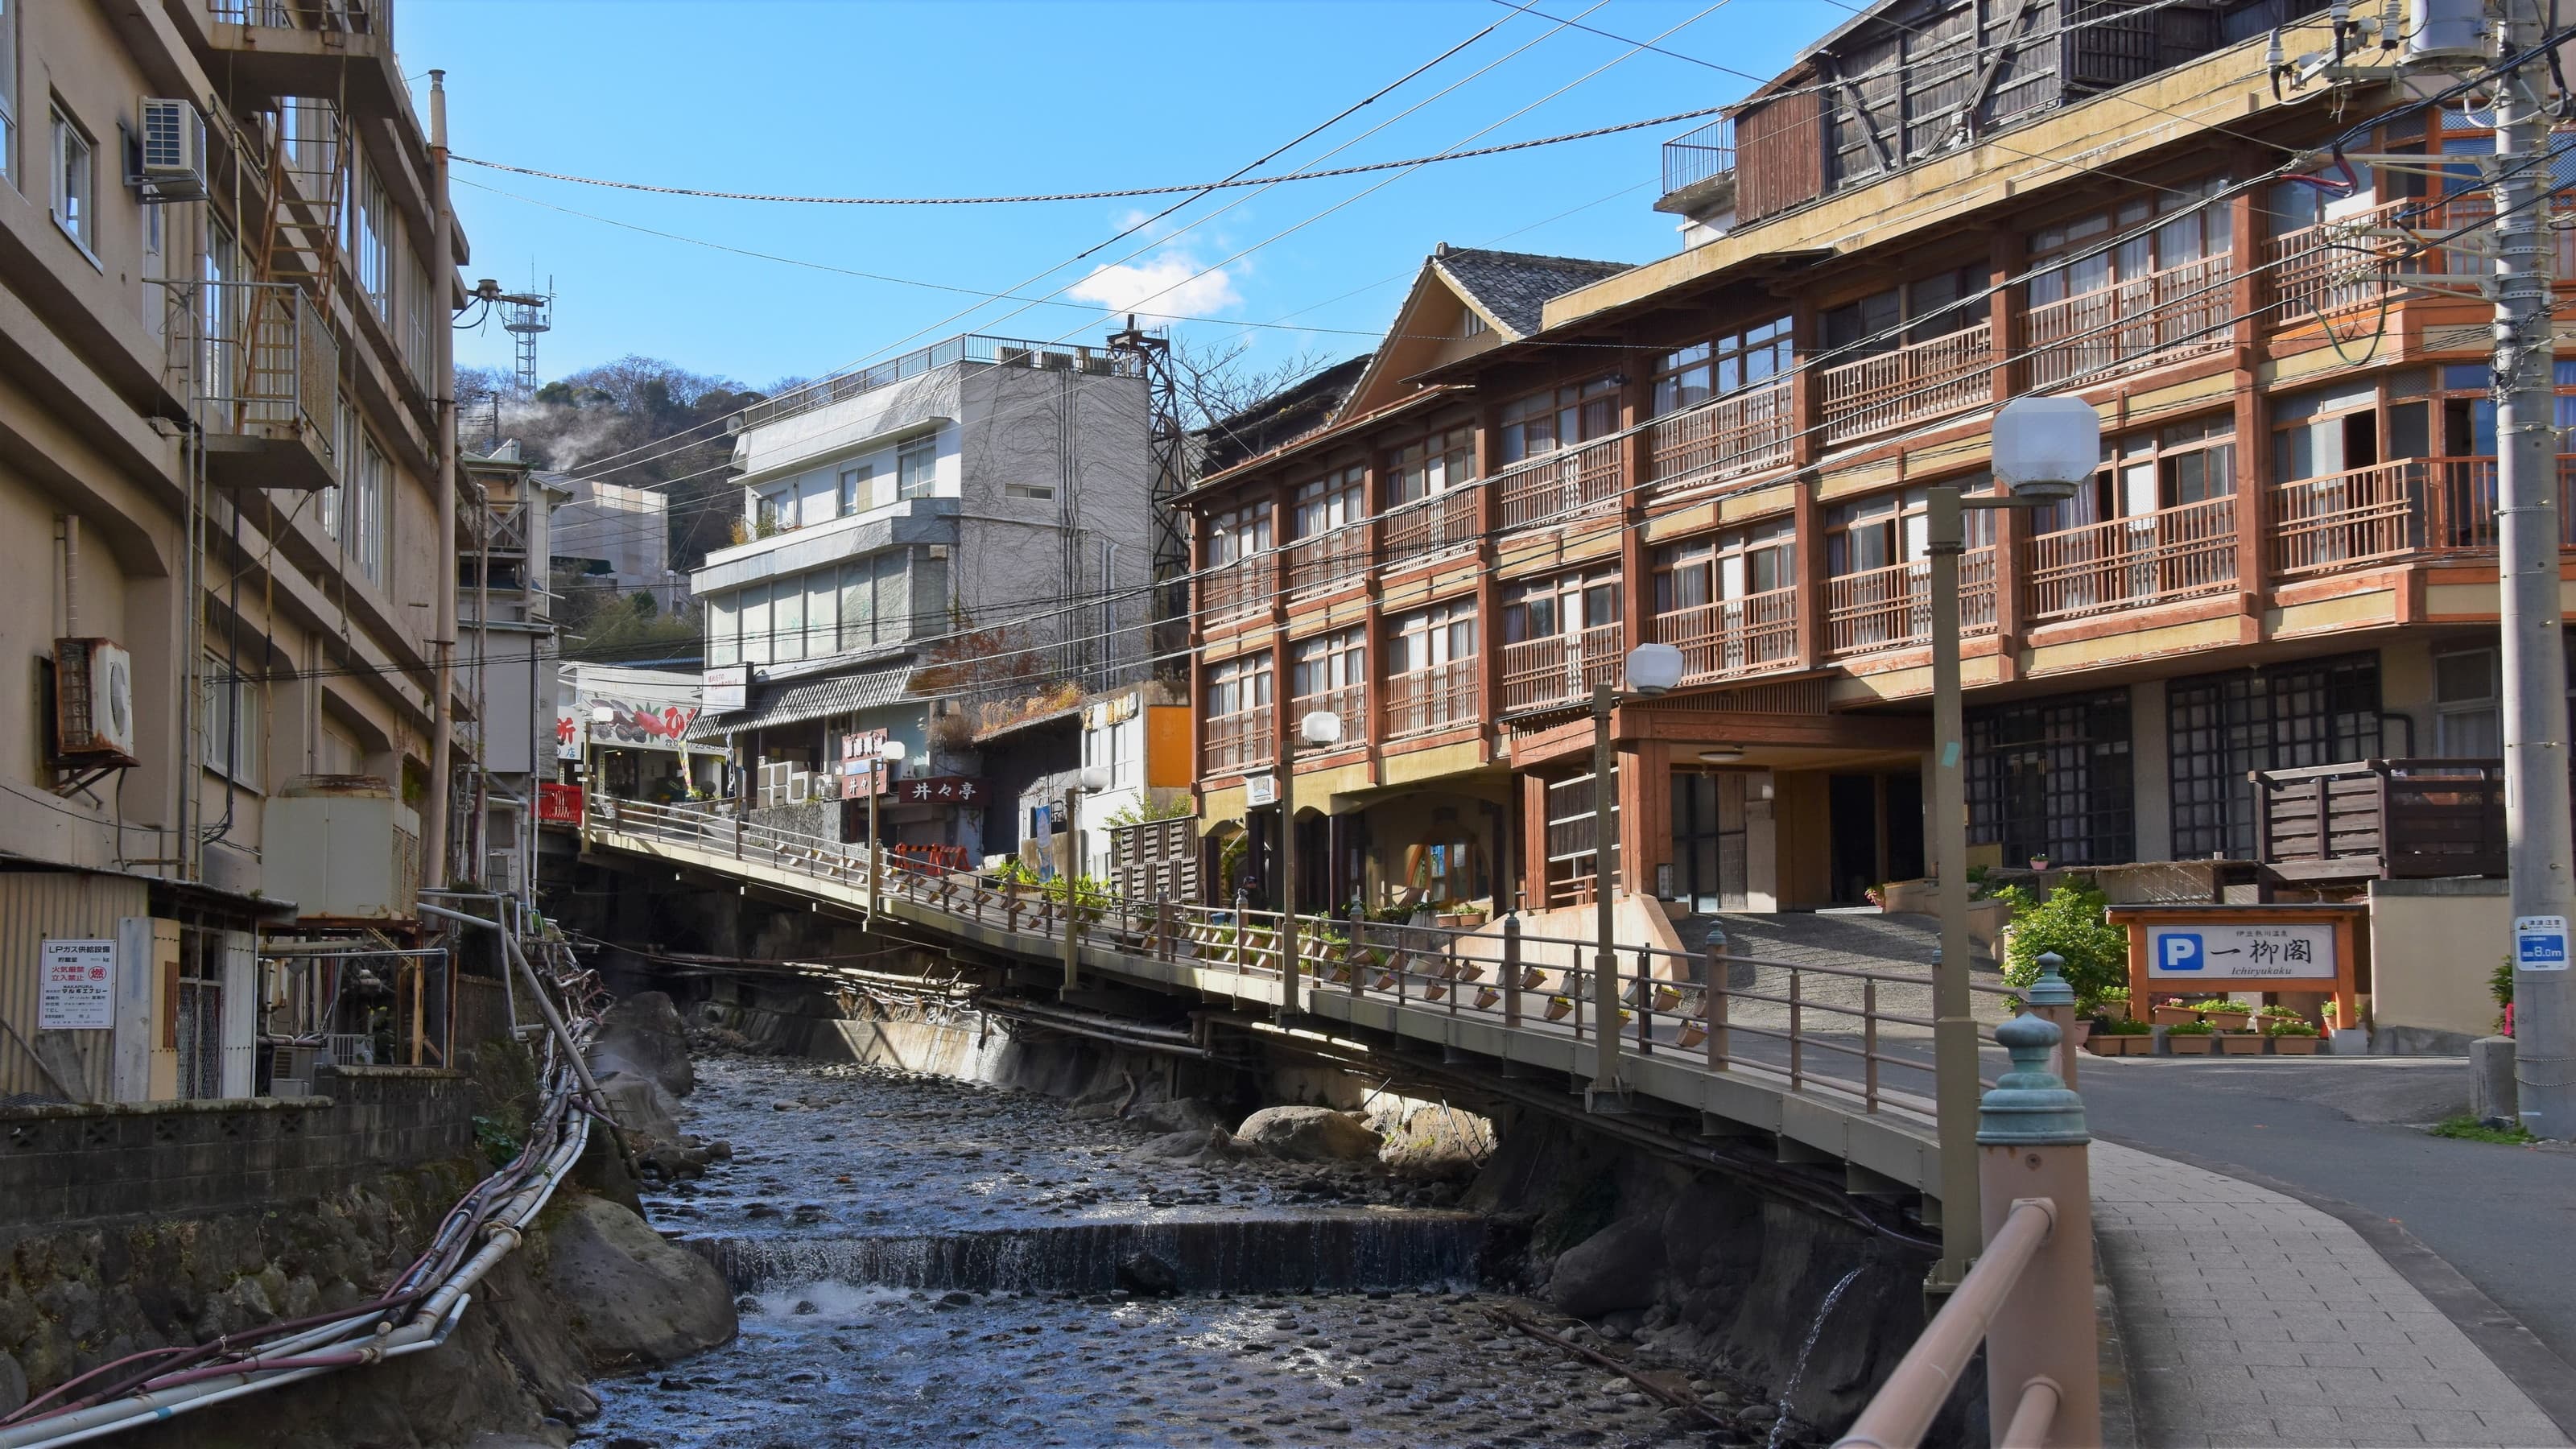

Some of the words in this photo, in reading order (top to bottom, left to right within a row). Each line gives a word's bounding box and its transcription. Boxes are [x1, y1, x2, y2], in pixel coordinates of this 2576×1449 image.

[848, 775, 881, 795] 井々
[912, 782, 976, 800] 井々亭
[2166, 938, 2196, 966] P
[2211, 939, 2312, 965] 一柳閣
[2534, 946, 2562, 957] 8.0m
[90, 968, 105, 980] 燃
[2231, 966, 2293, 976] Ichiryukaku
